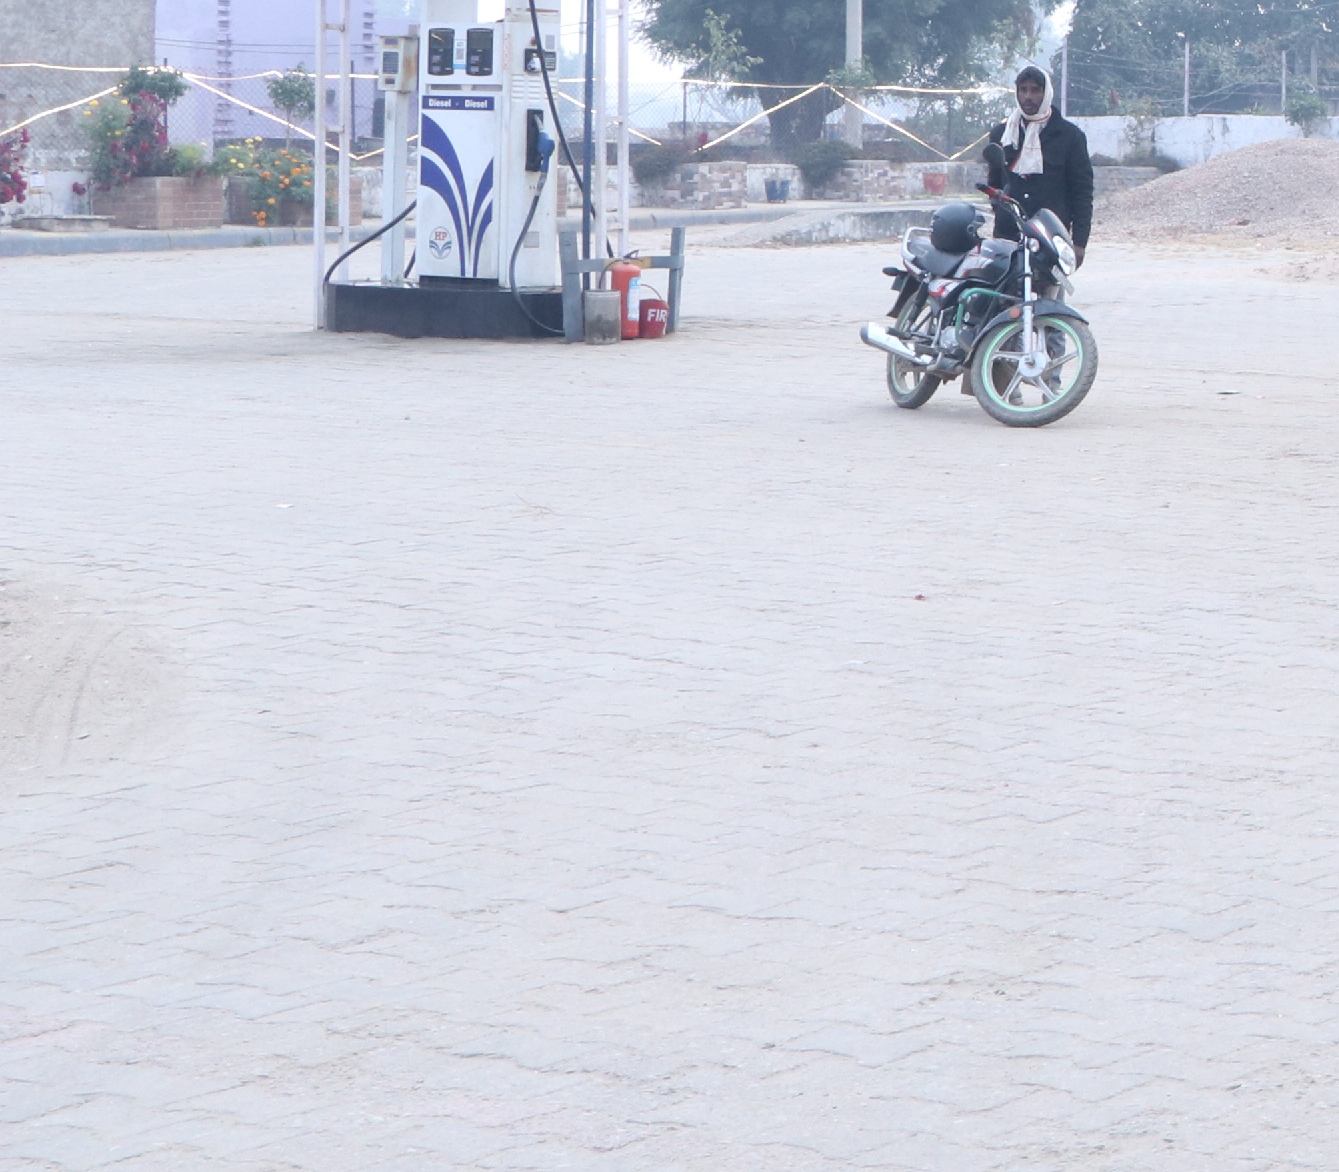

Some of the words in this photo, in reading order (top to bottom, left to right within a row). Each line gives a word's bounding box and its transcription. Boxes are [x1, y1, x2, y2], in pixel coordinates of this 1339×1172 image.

[428, 98, 452, 107] Diesel
[464, 99, 488, 108] Diesel
[434, 231, 448, 241] HP
[647, 309, 668, 322] FIR
